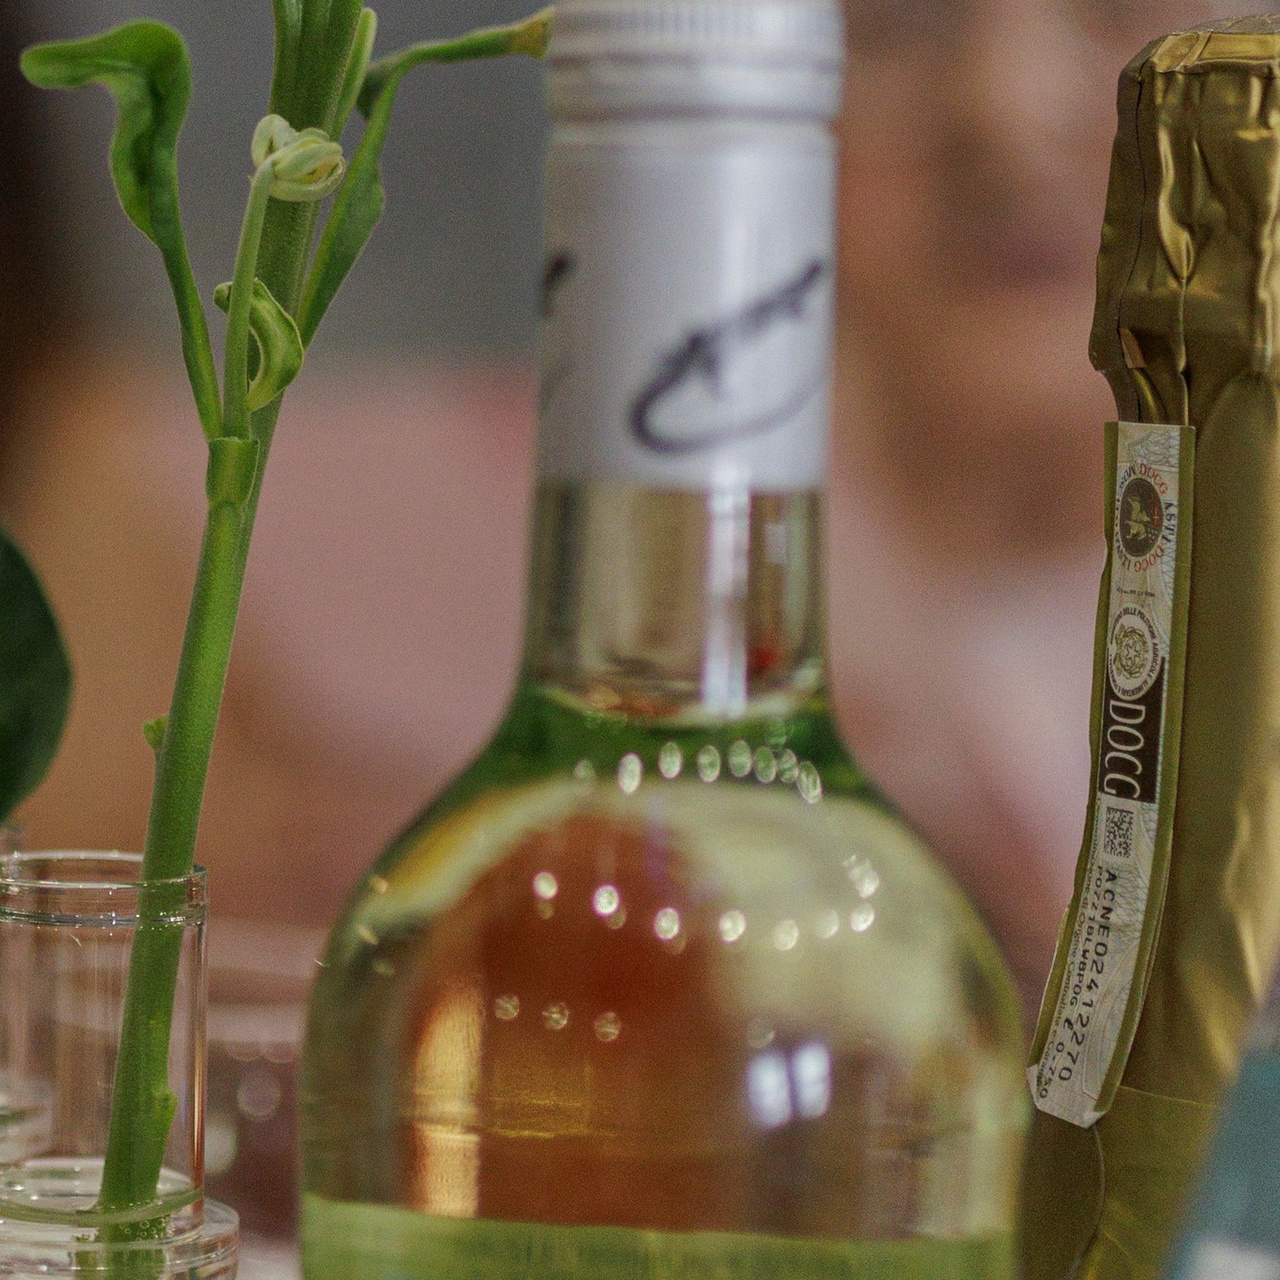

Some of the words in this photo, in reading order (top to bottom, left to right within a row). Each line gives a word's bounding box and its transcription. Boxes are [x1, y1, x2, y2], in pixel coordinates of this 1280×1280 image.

[1103, 699, 1146, 798] DOCG
[1058, 869, 1118, 1081] ACNE02412270
[1071, 912, 1086, 958] Origine
